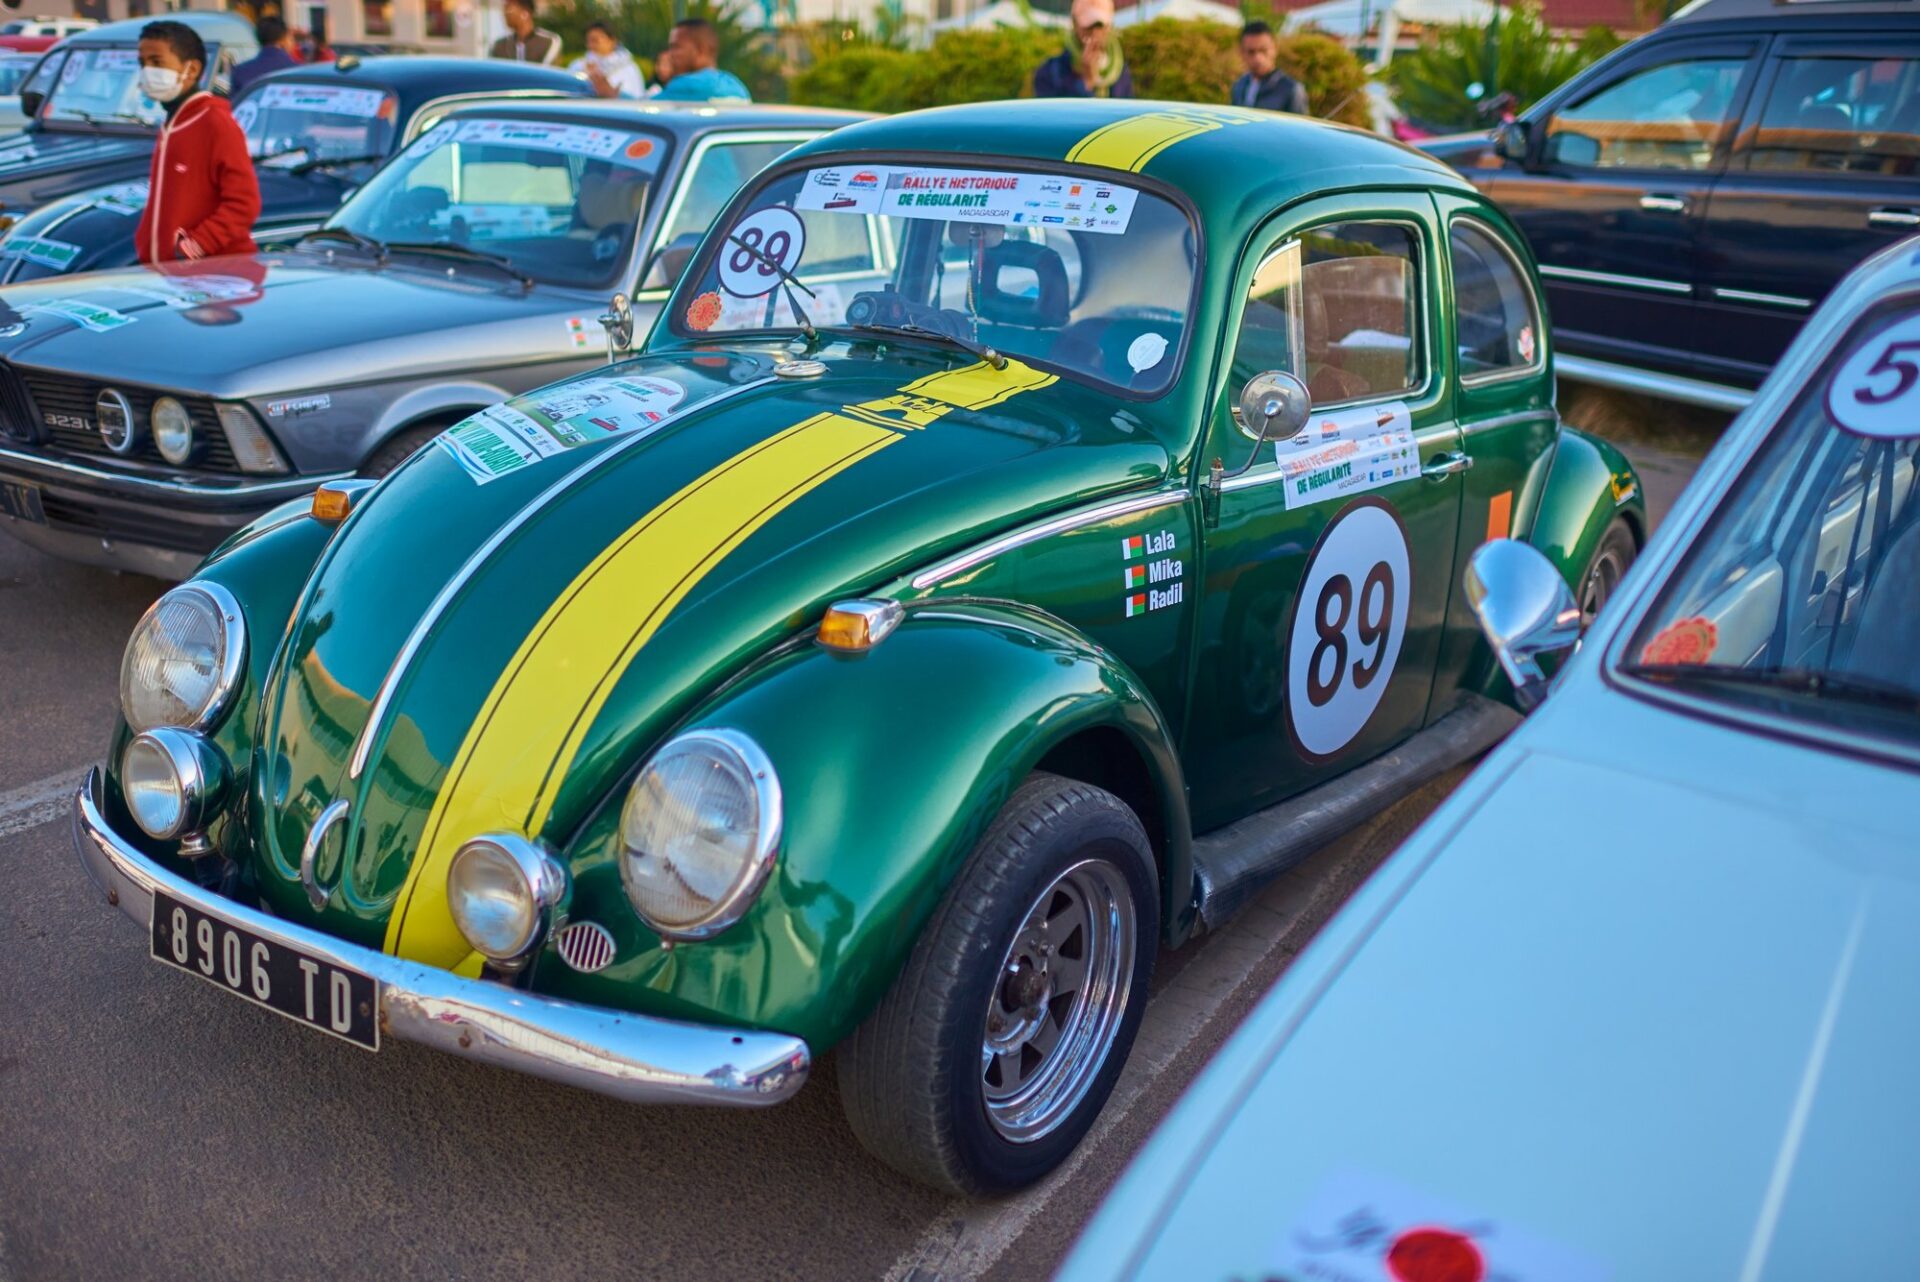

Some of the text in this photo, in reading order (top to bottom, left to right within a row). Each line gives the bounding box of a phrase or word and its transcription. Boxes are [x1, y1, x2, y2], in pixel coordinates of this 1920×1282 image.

[903, 175, 1019, 190] RALLYE HISTORIQUE
[897, 189, 989, 207] DE RÉGULARITÉ
[958, 208, 1010, 217] MADAGASCAR
[729, 226, 791, 276] 89
[1296, 478, 1308, 495] DE
[1145, 529, 1176, 555] Lala
[1148, 558, 1183, 584] Mika
[1149, 582, 1183, 611] Radil
[1306, 560, 1395, 708] 89
[171, 907, 352, 1034] 8906 TD
